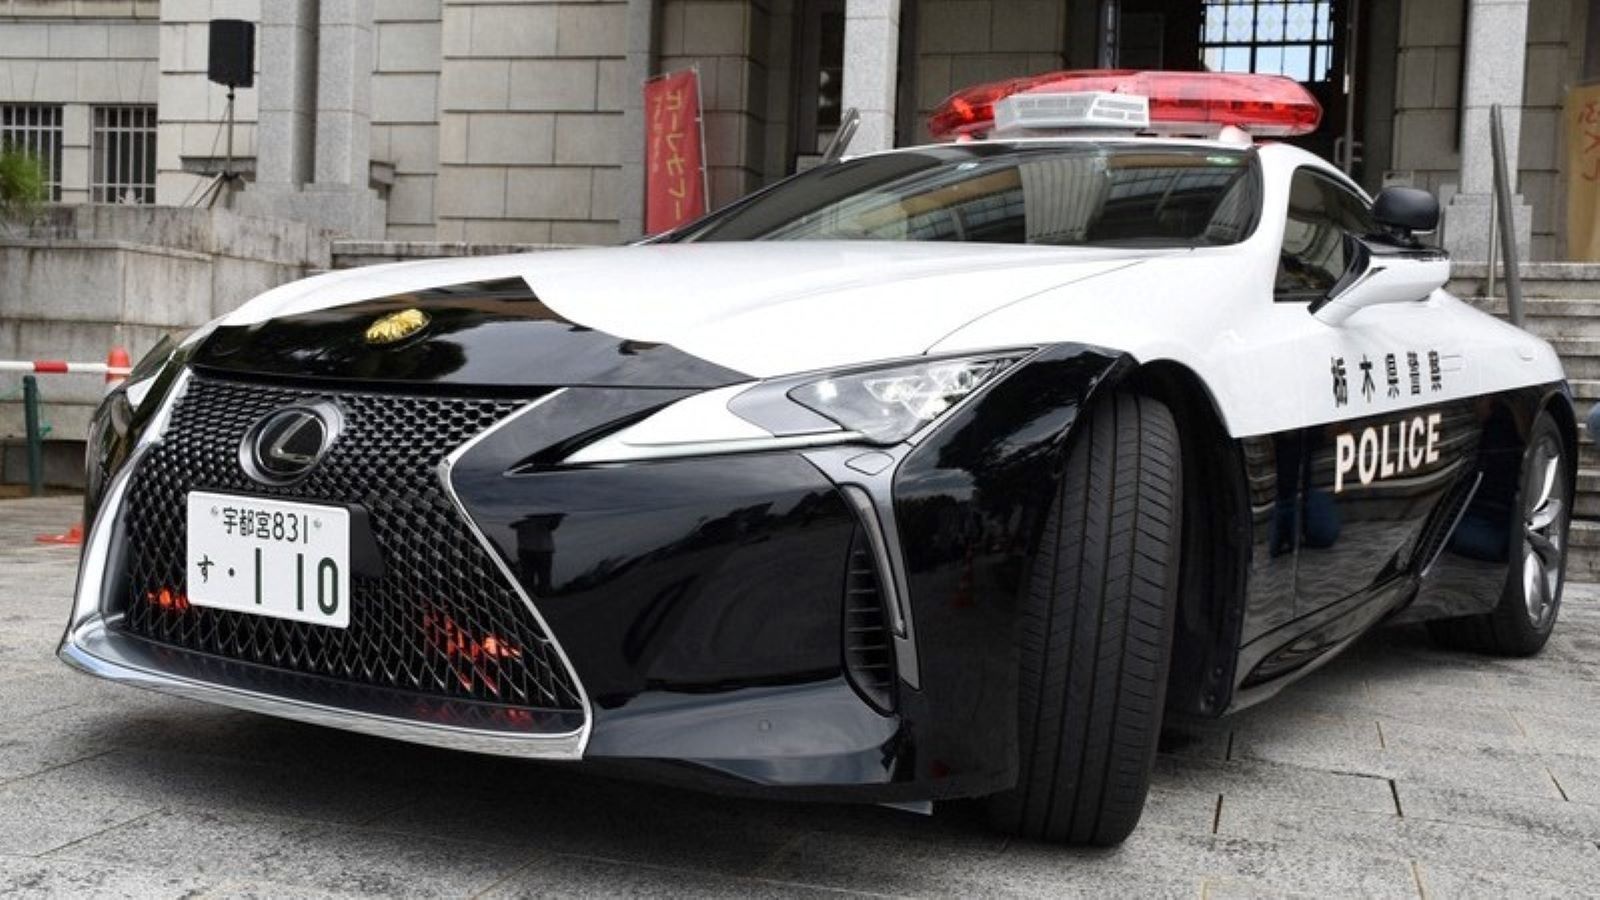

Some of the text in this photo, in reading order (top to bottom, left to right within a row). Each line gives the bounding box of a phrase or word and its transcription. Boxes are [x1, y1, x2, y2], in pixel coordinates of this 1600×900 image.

[1331, 350, 1442, 408] 栃木県警察
[1334, 413, 1442, 493] POLICE
